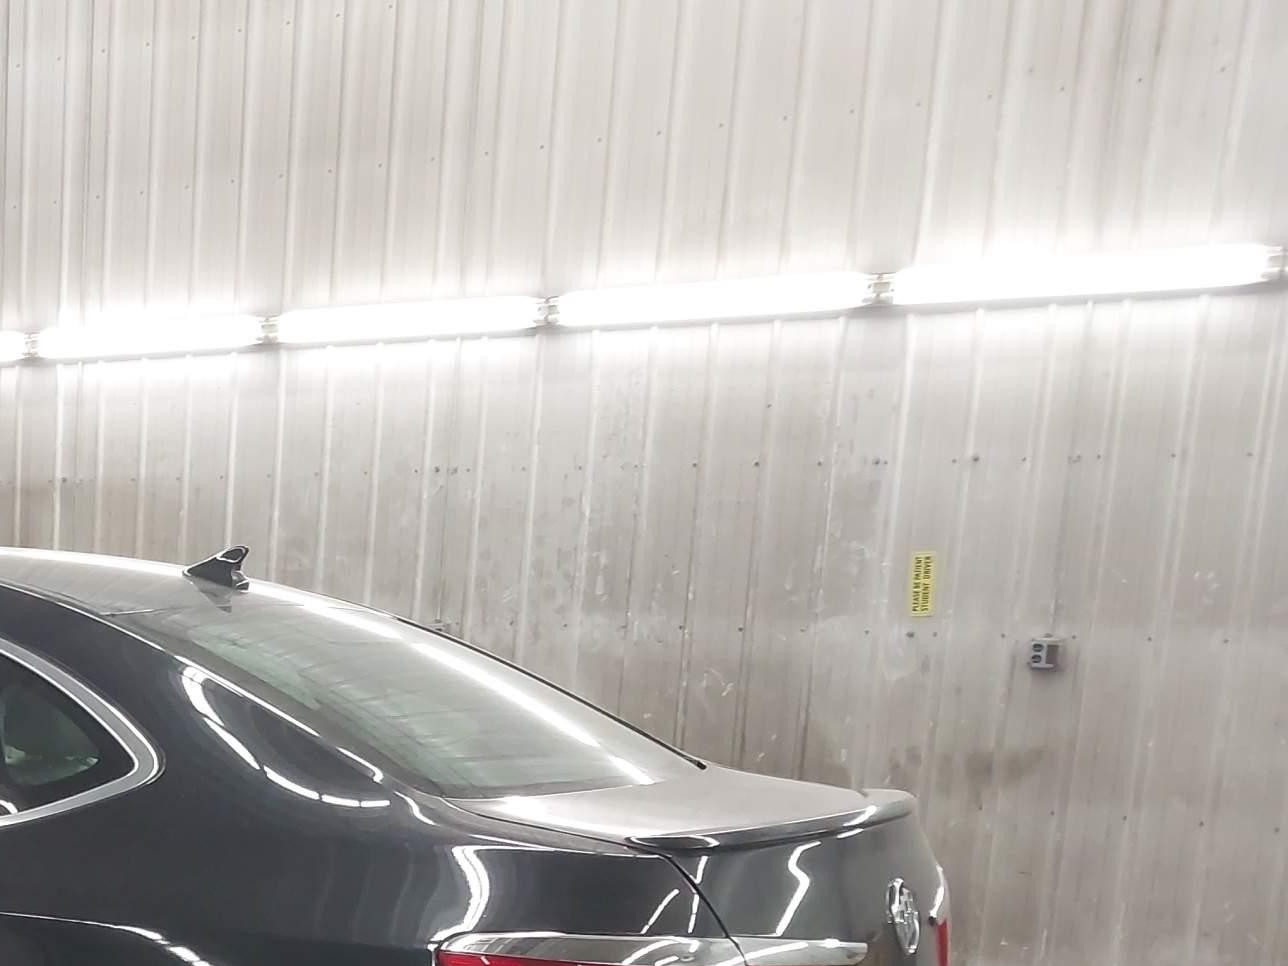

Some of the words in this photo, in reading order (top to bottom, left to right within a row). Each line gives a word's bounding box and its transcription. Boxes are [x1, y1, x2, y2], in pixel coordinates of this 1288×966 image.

[914, 557, 922, 580] PATIENT
[923, 556, 931, 579] DRIVER
[912, 591, 920, 611] PLEASE
[921, 583, 930, 611] STUDENT
